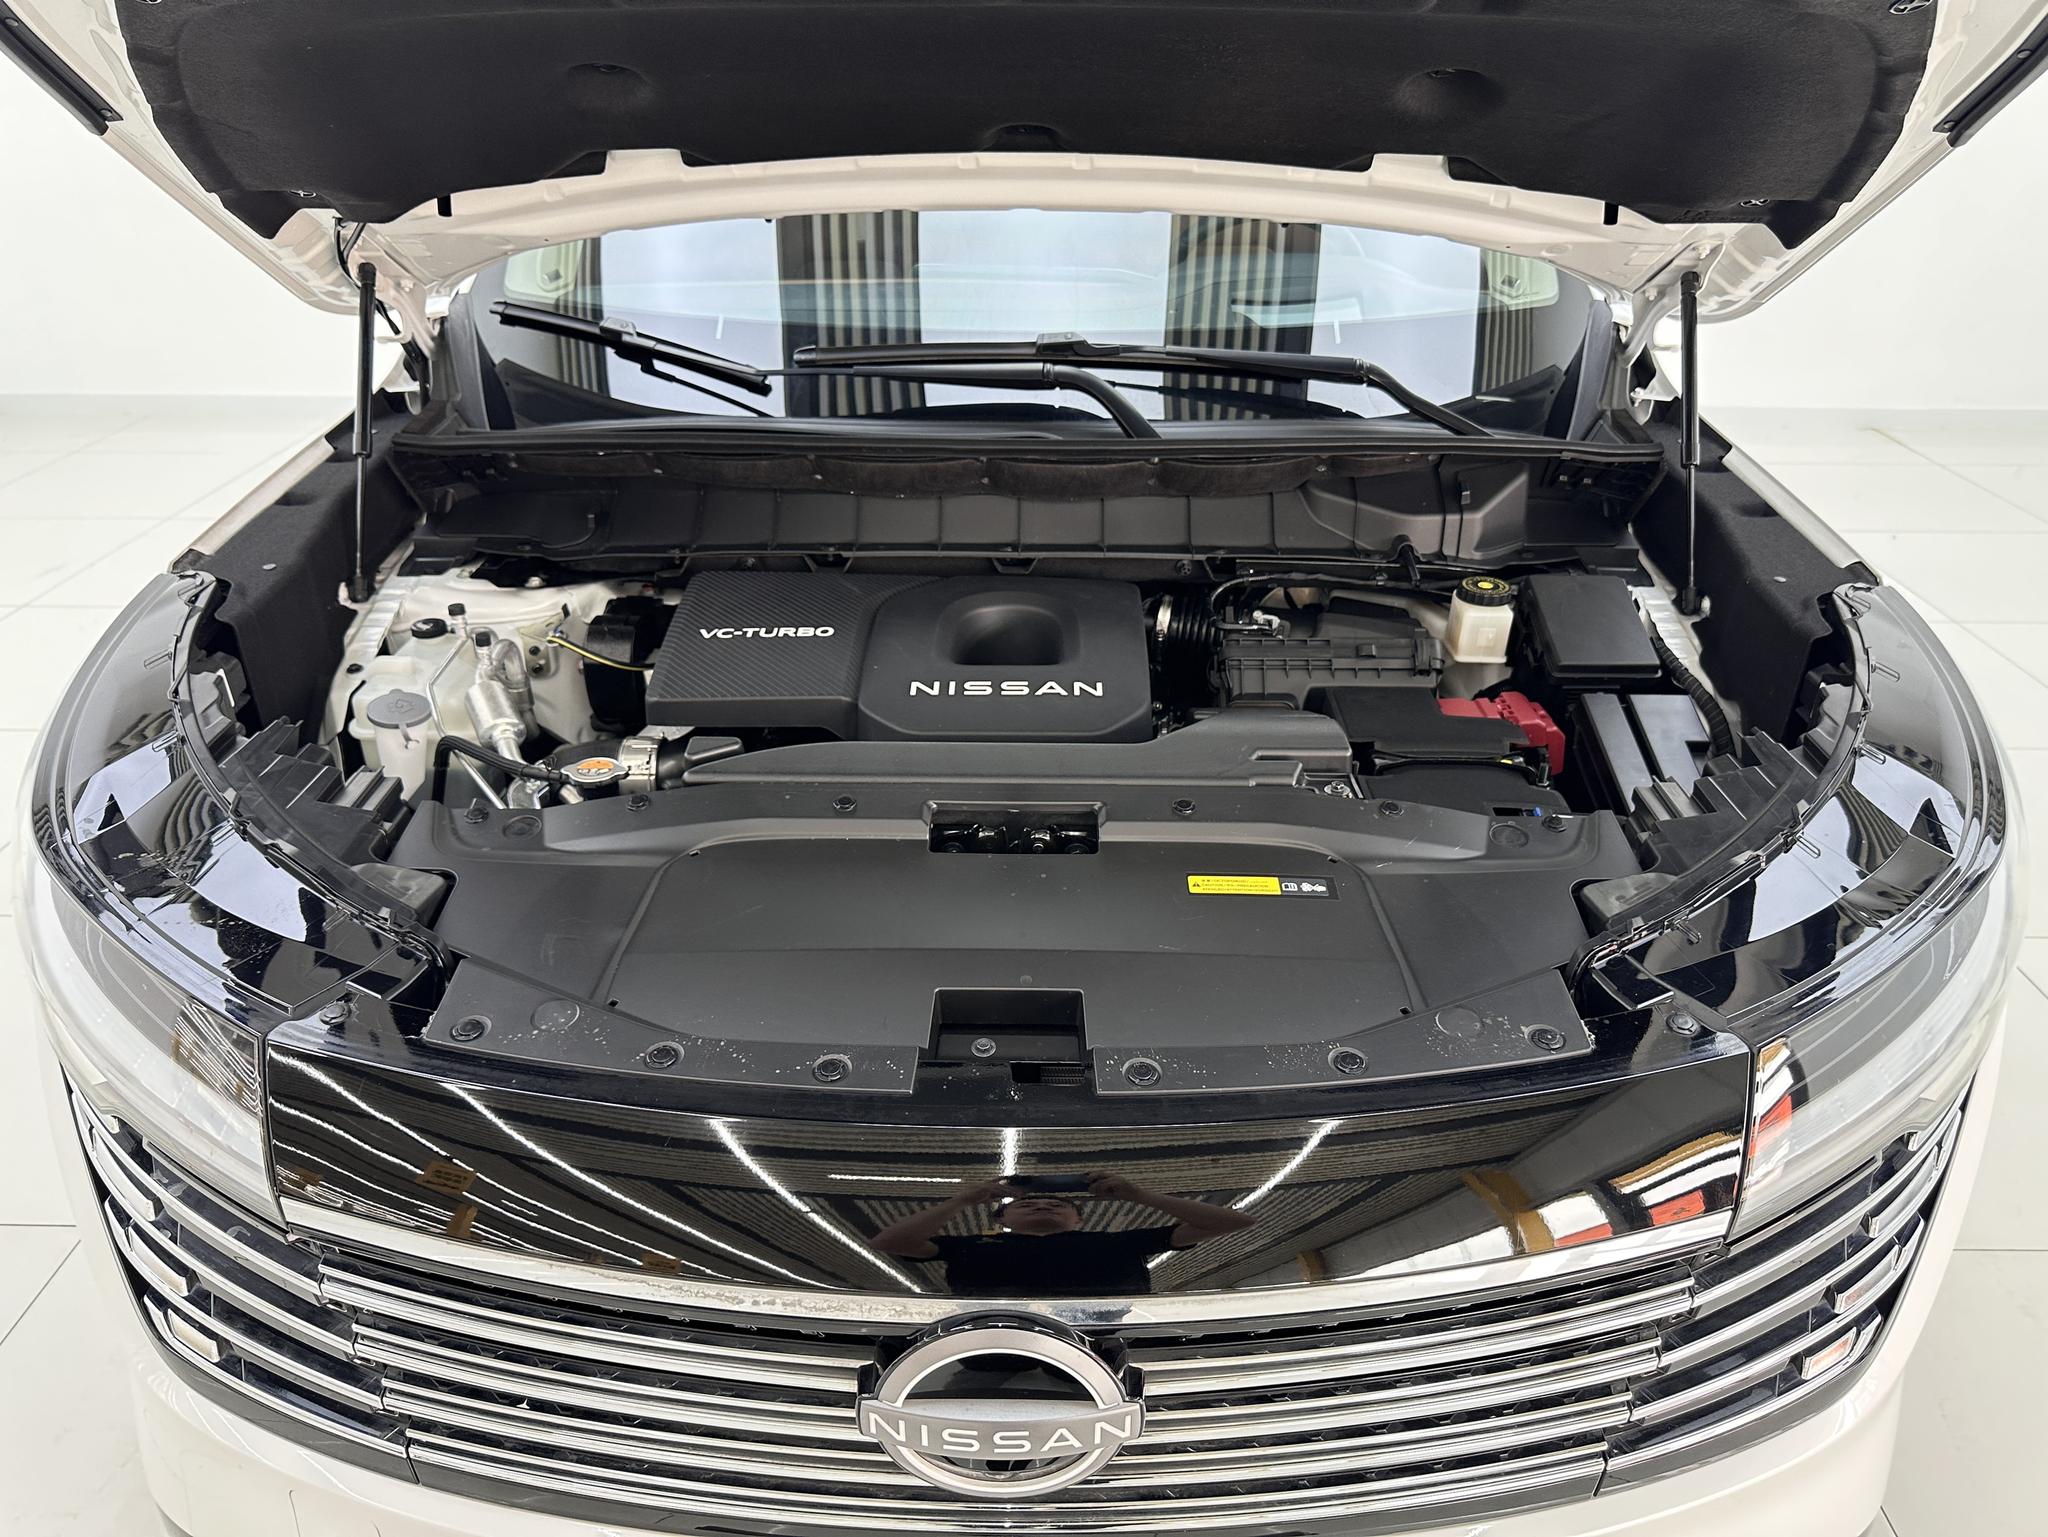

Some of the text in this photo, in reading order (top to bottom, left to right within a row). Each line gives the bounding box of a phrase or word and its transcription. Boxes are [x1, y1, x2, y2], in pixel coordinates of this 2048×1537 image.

[699, 626, 835, 639] VC-TURBO
[909, 680, 1104, 697] NISSAN
[868, 1412, 1133, 1454] NISSAN
